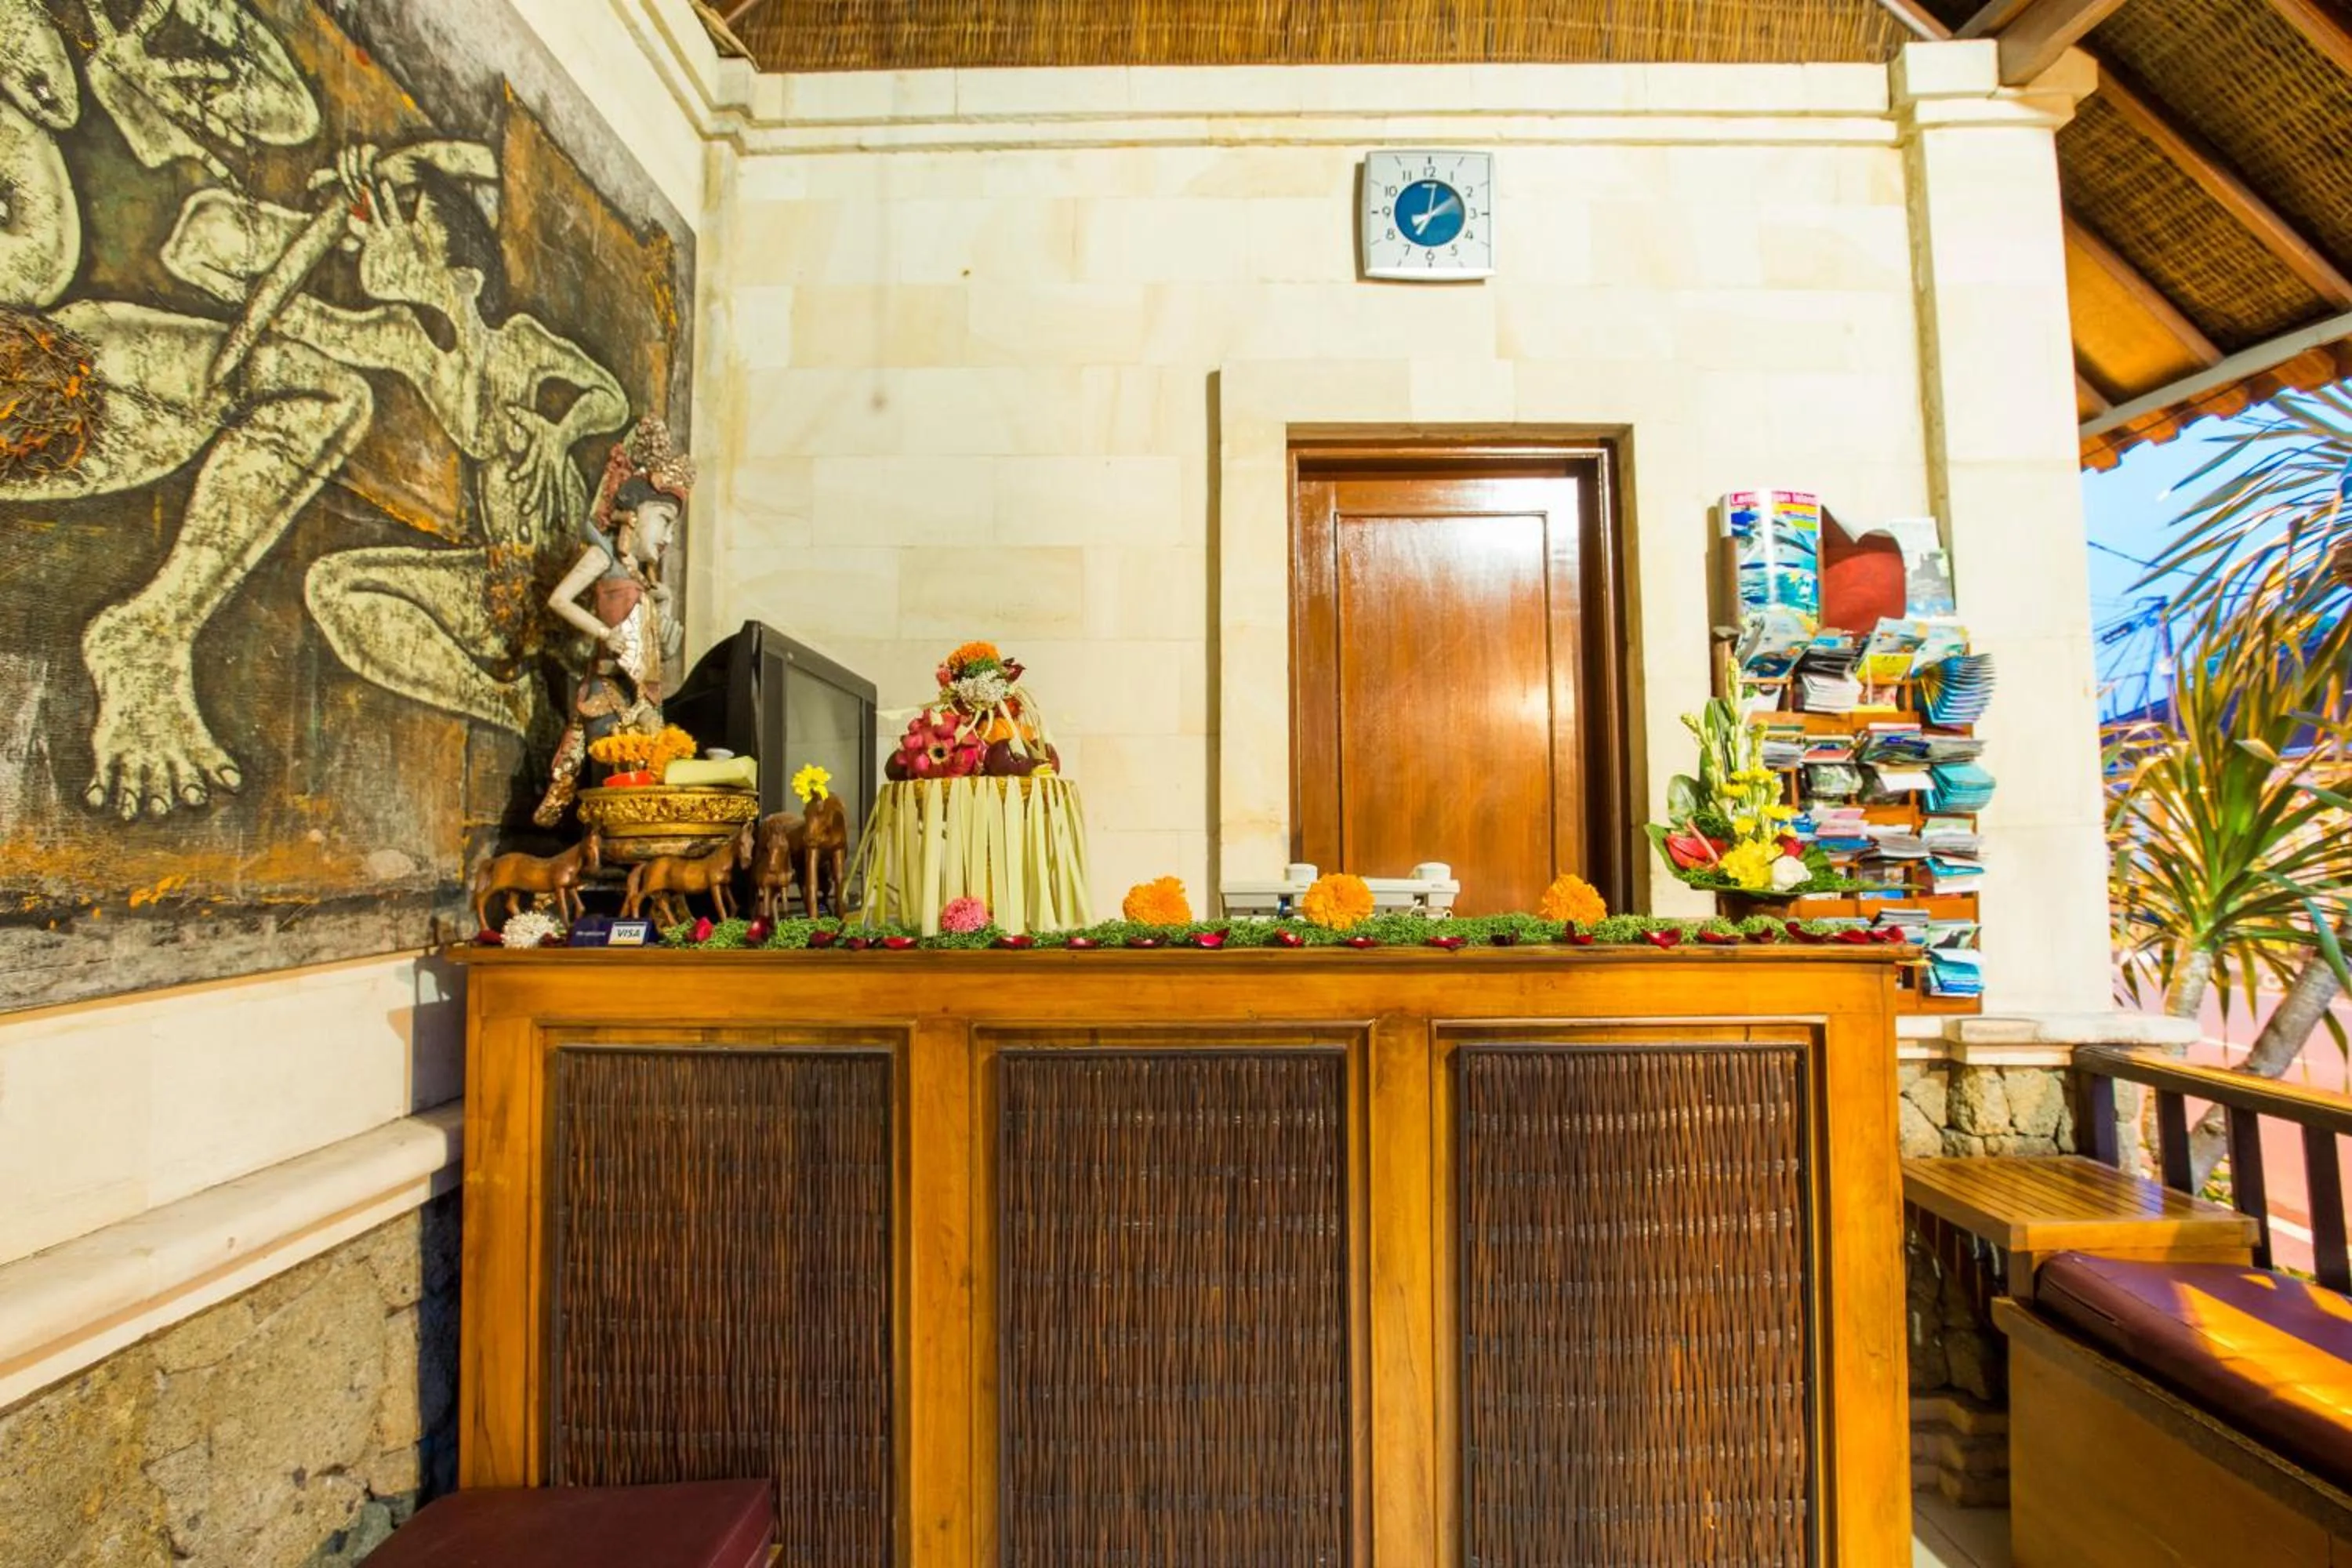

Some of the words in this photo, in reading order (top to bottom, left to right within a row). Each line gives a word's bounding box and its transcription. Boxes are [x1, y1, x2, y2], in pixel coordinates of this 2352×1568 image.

[1403, 170, 1412, 182] 11
[1423, 166, 1436, 178] 12
[1385, 185, 1398, 197] 10
[1465, 186, 1474, 198] 2
[1381, 205, 1392, 219] 9
[1468, 207, 1478, 220] 3
[1385, 228, 1396, 241] 8
[1465, 230, 1474, 240] 4
[1404, 244, 1411, 256] 7
[1425, 246, 1436, 261] 6
[1450, 244, 1458, 256] 5
[616, 928, 641, 938] VISA
